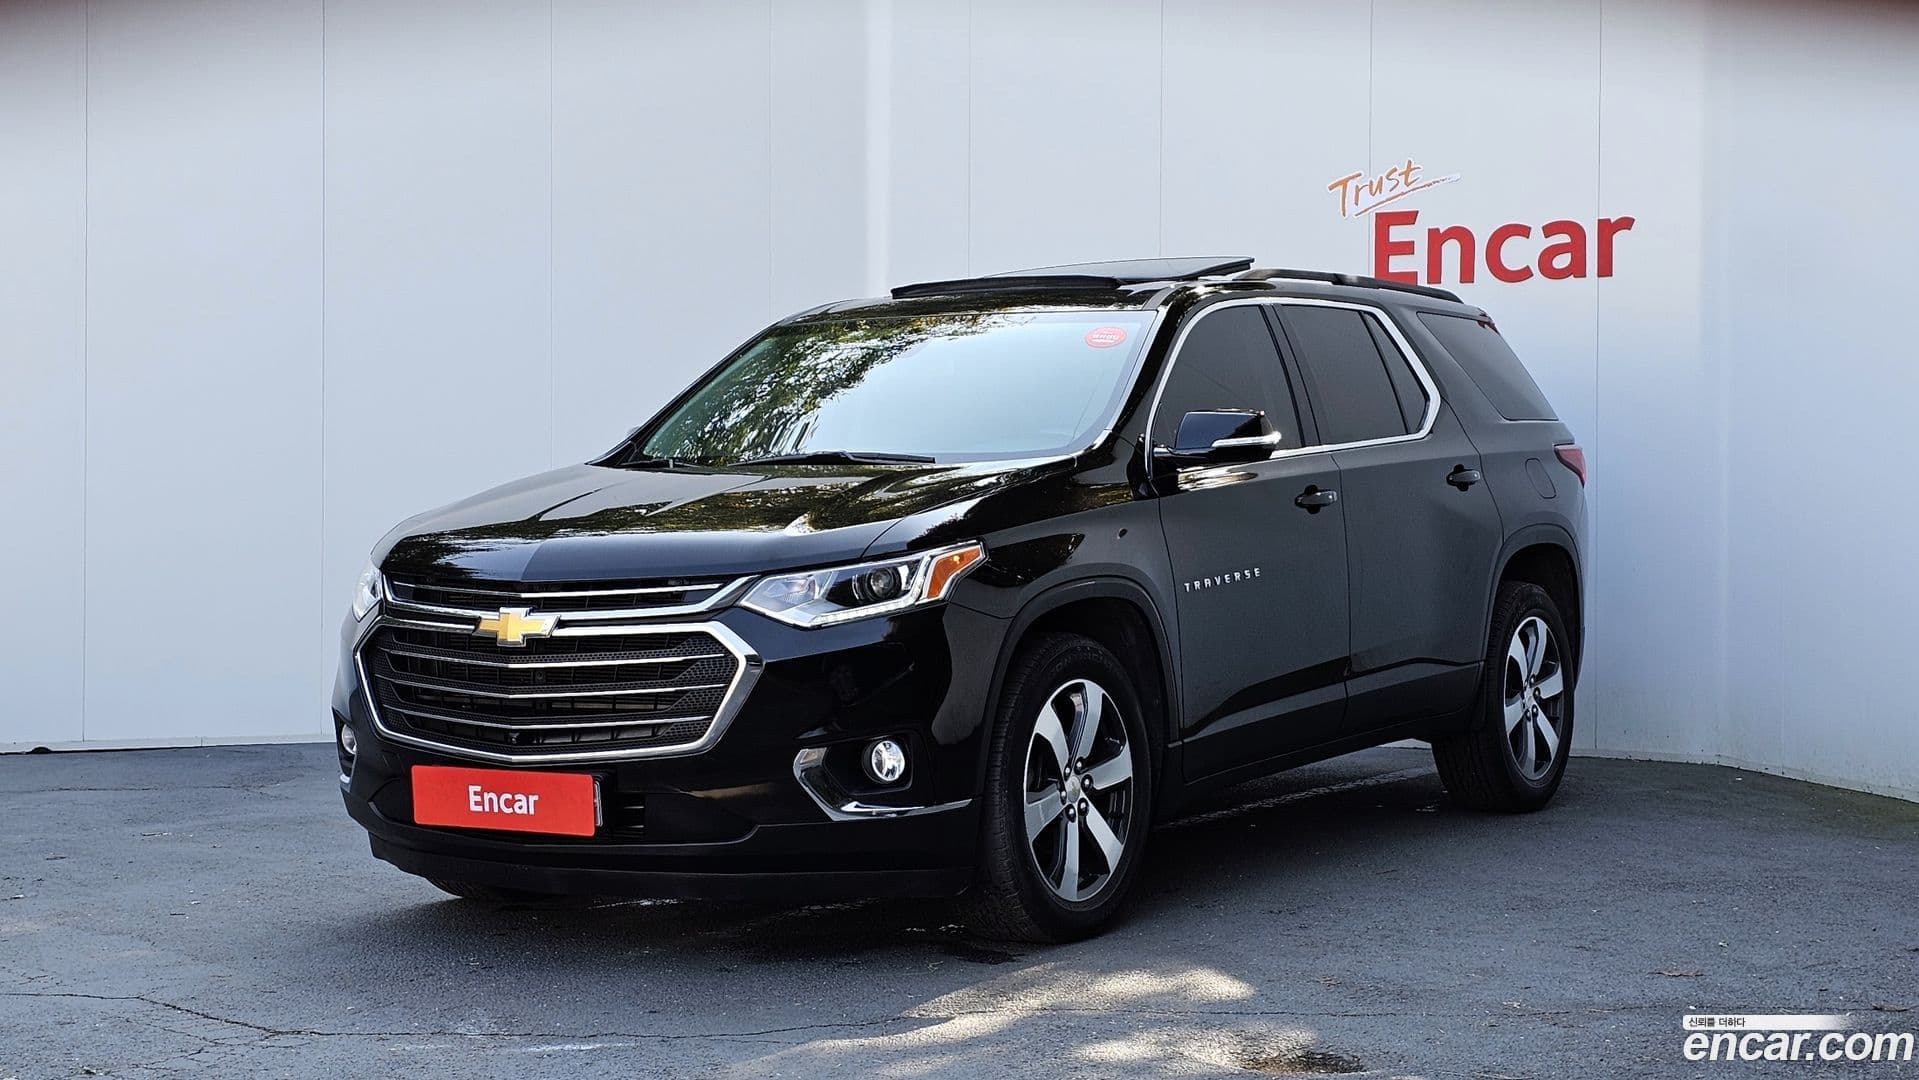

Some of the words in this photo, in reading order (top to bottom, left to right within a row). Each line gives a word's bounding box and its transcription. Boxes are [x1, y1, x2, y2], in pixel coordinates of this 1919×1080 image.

[1328, 159, 1421, 217] Trust
[1374, 210, 1635, 285] Encar
[1183, 567, 1261, 593] TRAVERSE
[468, 785, 539, 815] Encar
